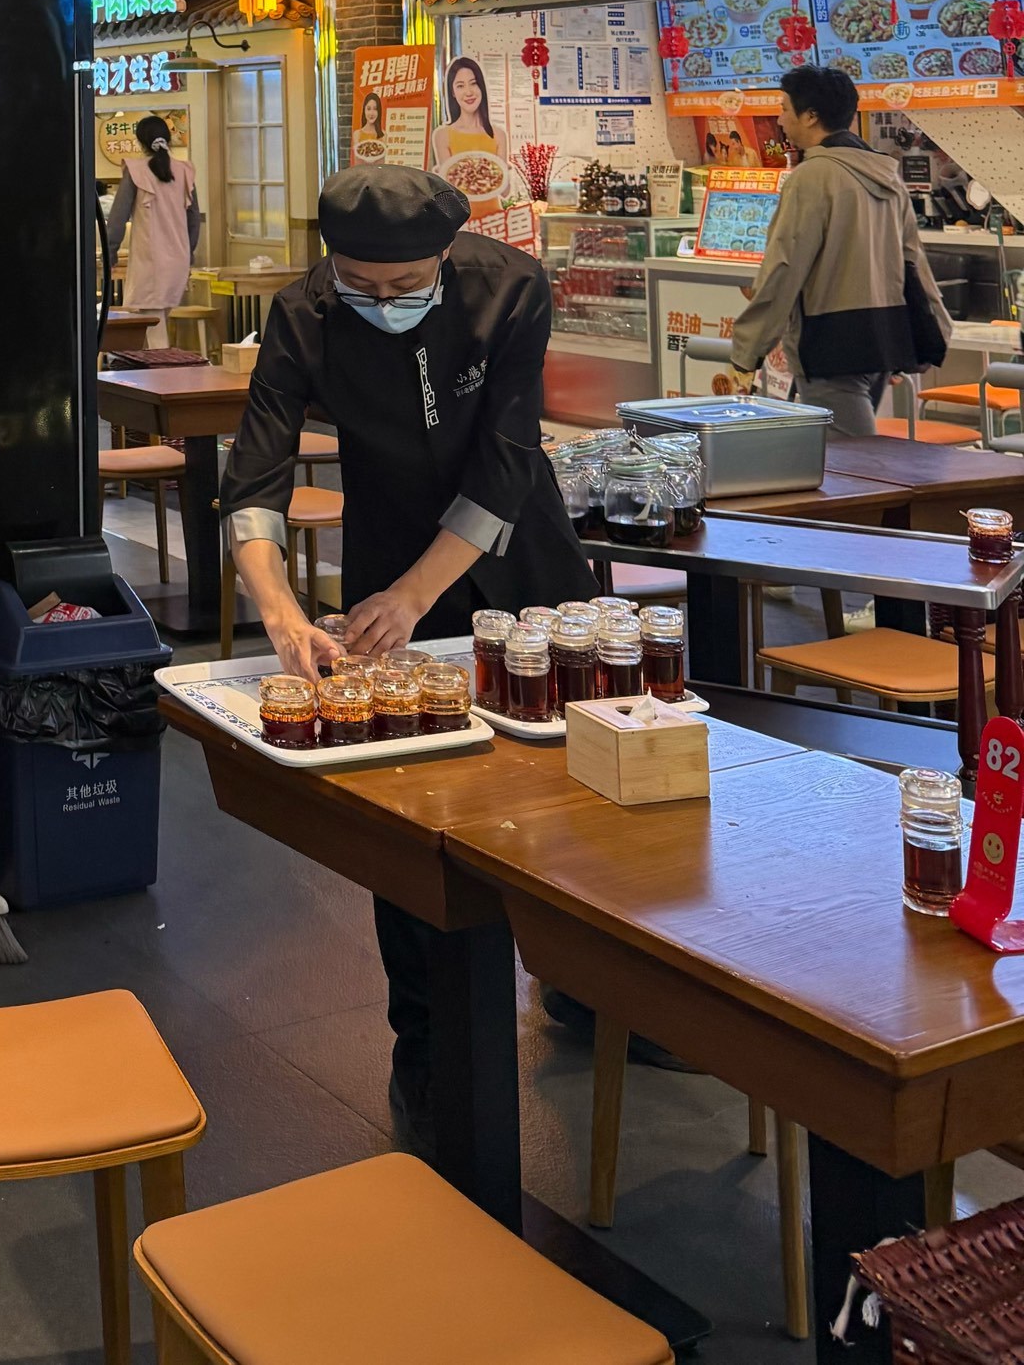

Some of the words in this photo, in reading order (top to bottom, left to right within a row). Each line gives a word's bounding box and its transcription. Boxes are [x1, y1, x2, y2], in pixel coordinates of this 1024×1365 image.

[359, 54, 410, 88] 招聘
[986, 737, 1021, 782] 82
[62, 799, 95, 812] Residual
[98, 796, 121, 807] Waste
[66, 779, 118, 802] 其他垃圾
